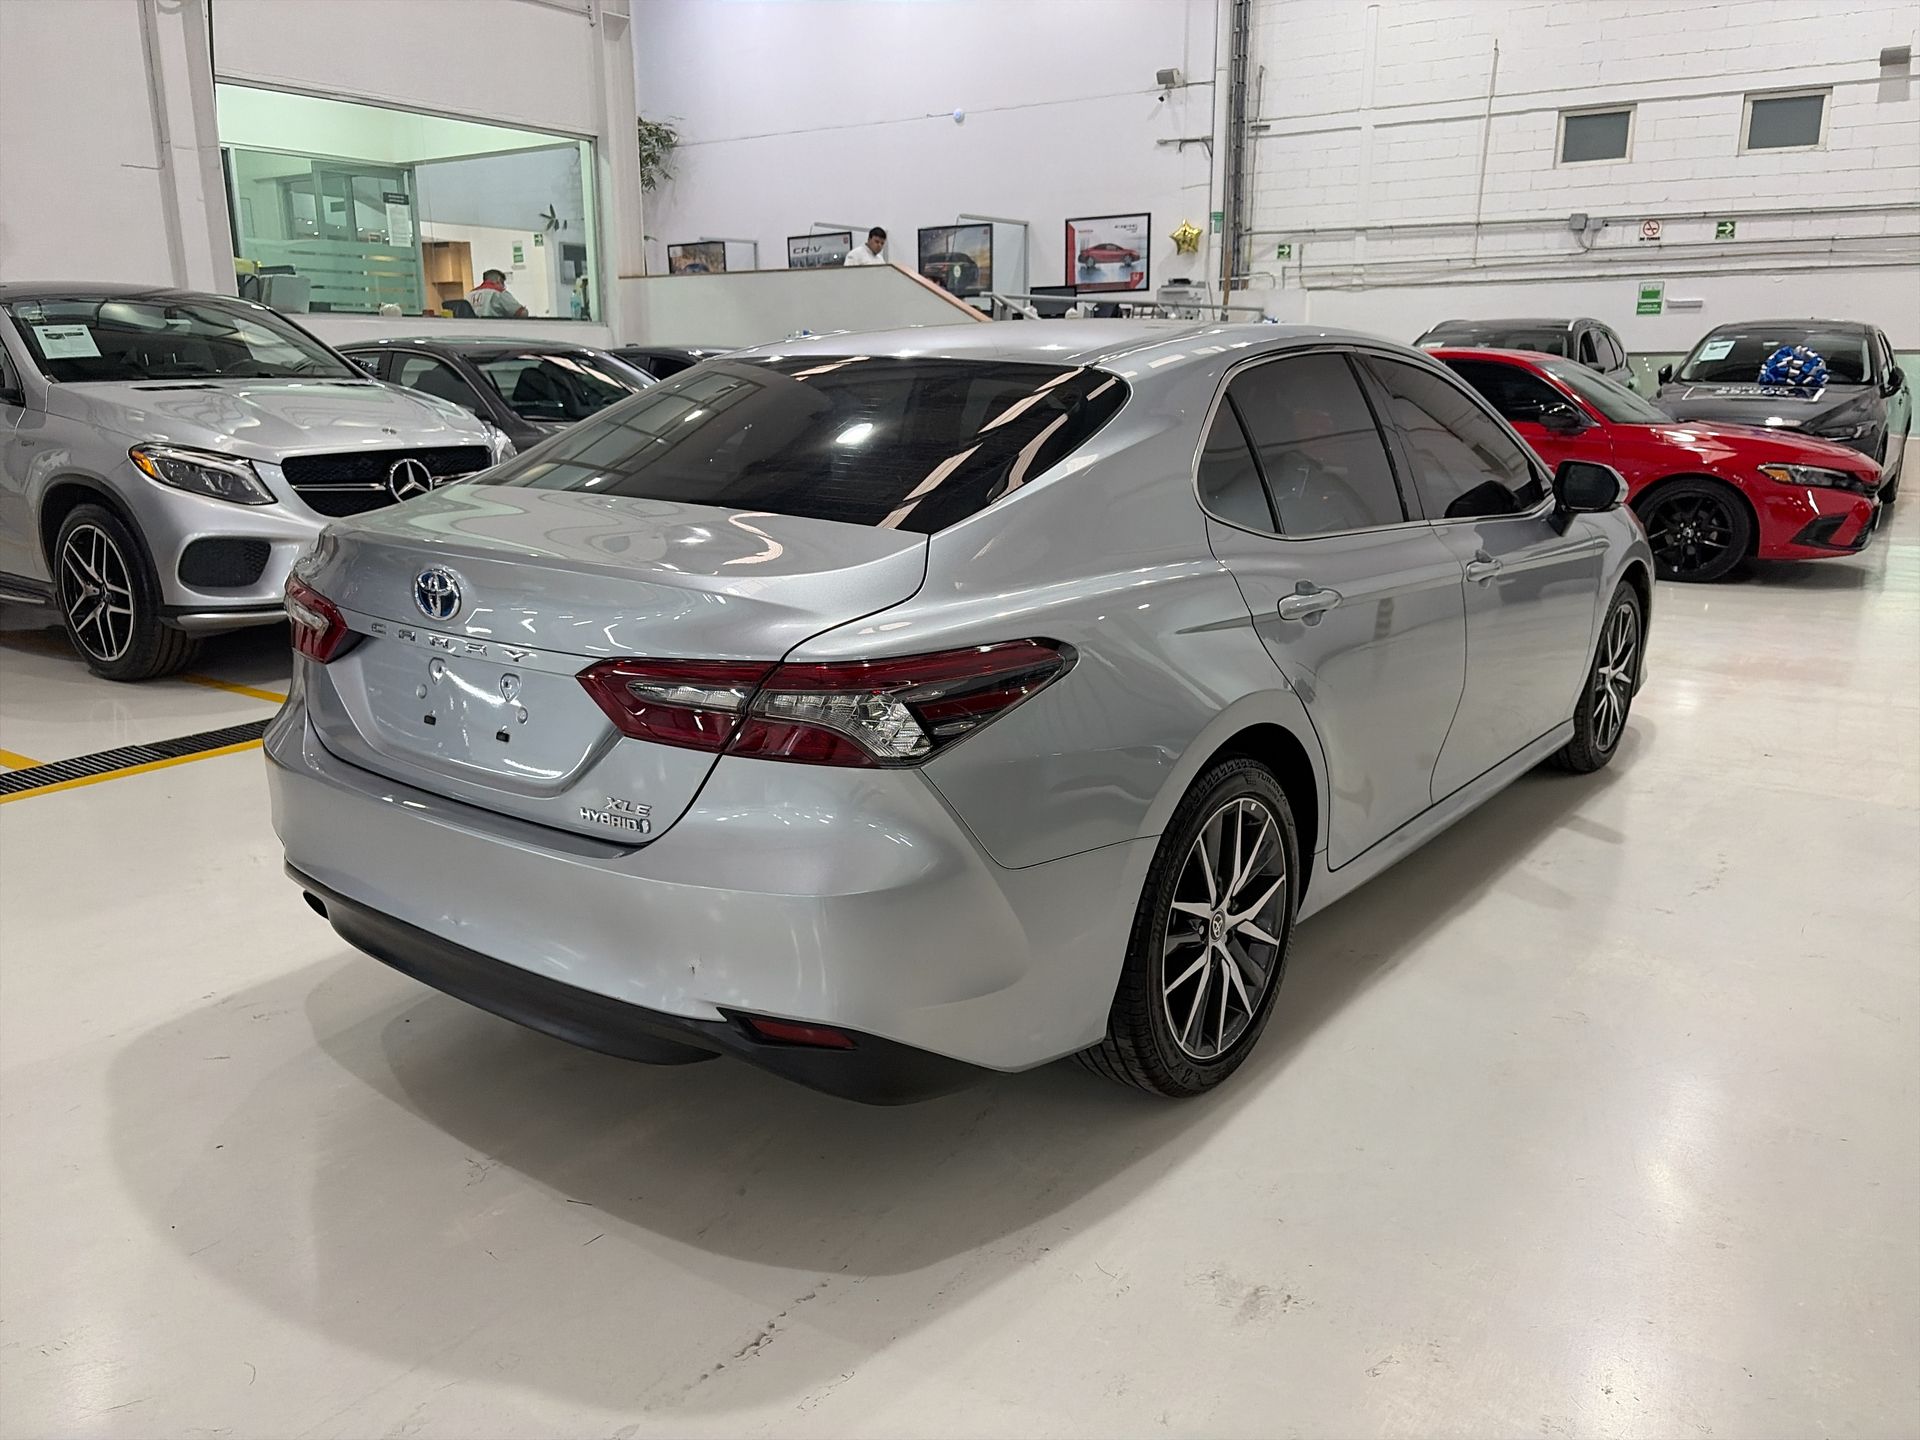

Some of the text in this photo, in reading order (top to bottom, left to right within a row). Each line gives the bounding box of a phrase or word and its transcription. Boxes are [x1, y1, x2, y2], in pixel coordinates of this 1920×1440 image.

[793, 245, 822, 255] CR-V
[371, 622, 538, 664] CAMRY
[604, 796, 652, 818] XLE
[579, 807, 640, 832] HYBRID
